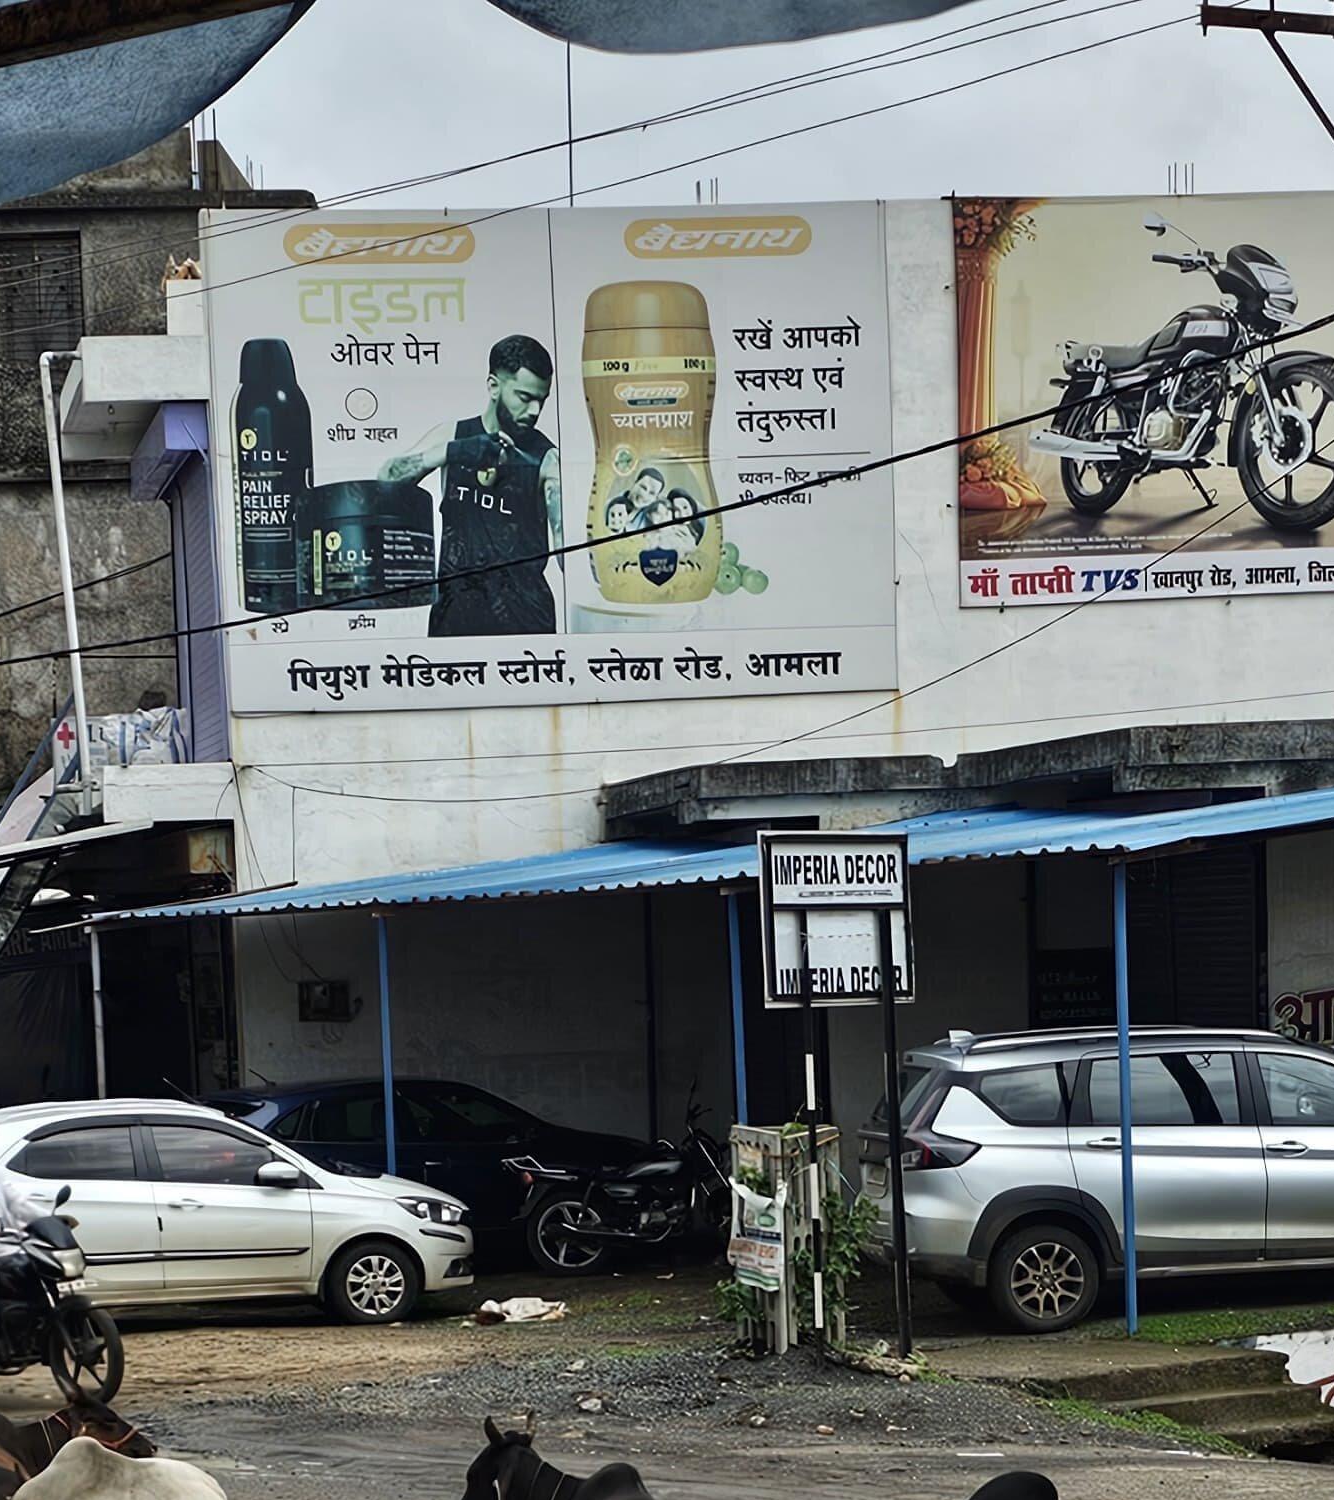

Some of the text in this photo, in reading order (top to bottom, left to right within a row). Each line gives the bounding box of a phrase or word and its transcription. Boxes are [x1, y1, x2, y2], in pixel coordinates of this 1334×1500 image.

[634, 223, 803, 250] बैद्यनाथ
[298, 277, 465, 334] टाइडल
[732, 316, 861, 350] रखें आपको
[331, 333, 441, 366] ओवर पेन
[734, 357, 845, 393] स्वस्थ एवं
[363, 427, 398, 442] राहत
[610, 411, 694, 429] च्यवनप्राश
[242, 480, 272, 494] PAIN
[243, 494, 291, 509] RELIEF
[244, 510, 287, 525] SPRAY
[967, 567, 999, 597] माँ
[1009, 565, 1075, 595] ताप्ती
[1080, 568, 1141, 592] TVS
[1152, 566, 1204, 595] खानपुर
[1209, 563, 1237, 590] रोड,
[1245, 562, 1300, 587] आमला,
[288, 658, 369, 700] पियुश
[381, 654, 487, 687] मेडिकल
[498, 649, 575, 689] स्टोर्स,
[674, 646, 732, 682] रोड,
[745, 650, 841, 681] आमला
[774, 854, 898, 885] IMPERIA DECOR
[850, 966, 903, 993] DECR
